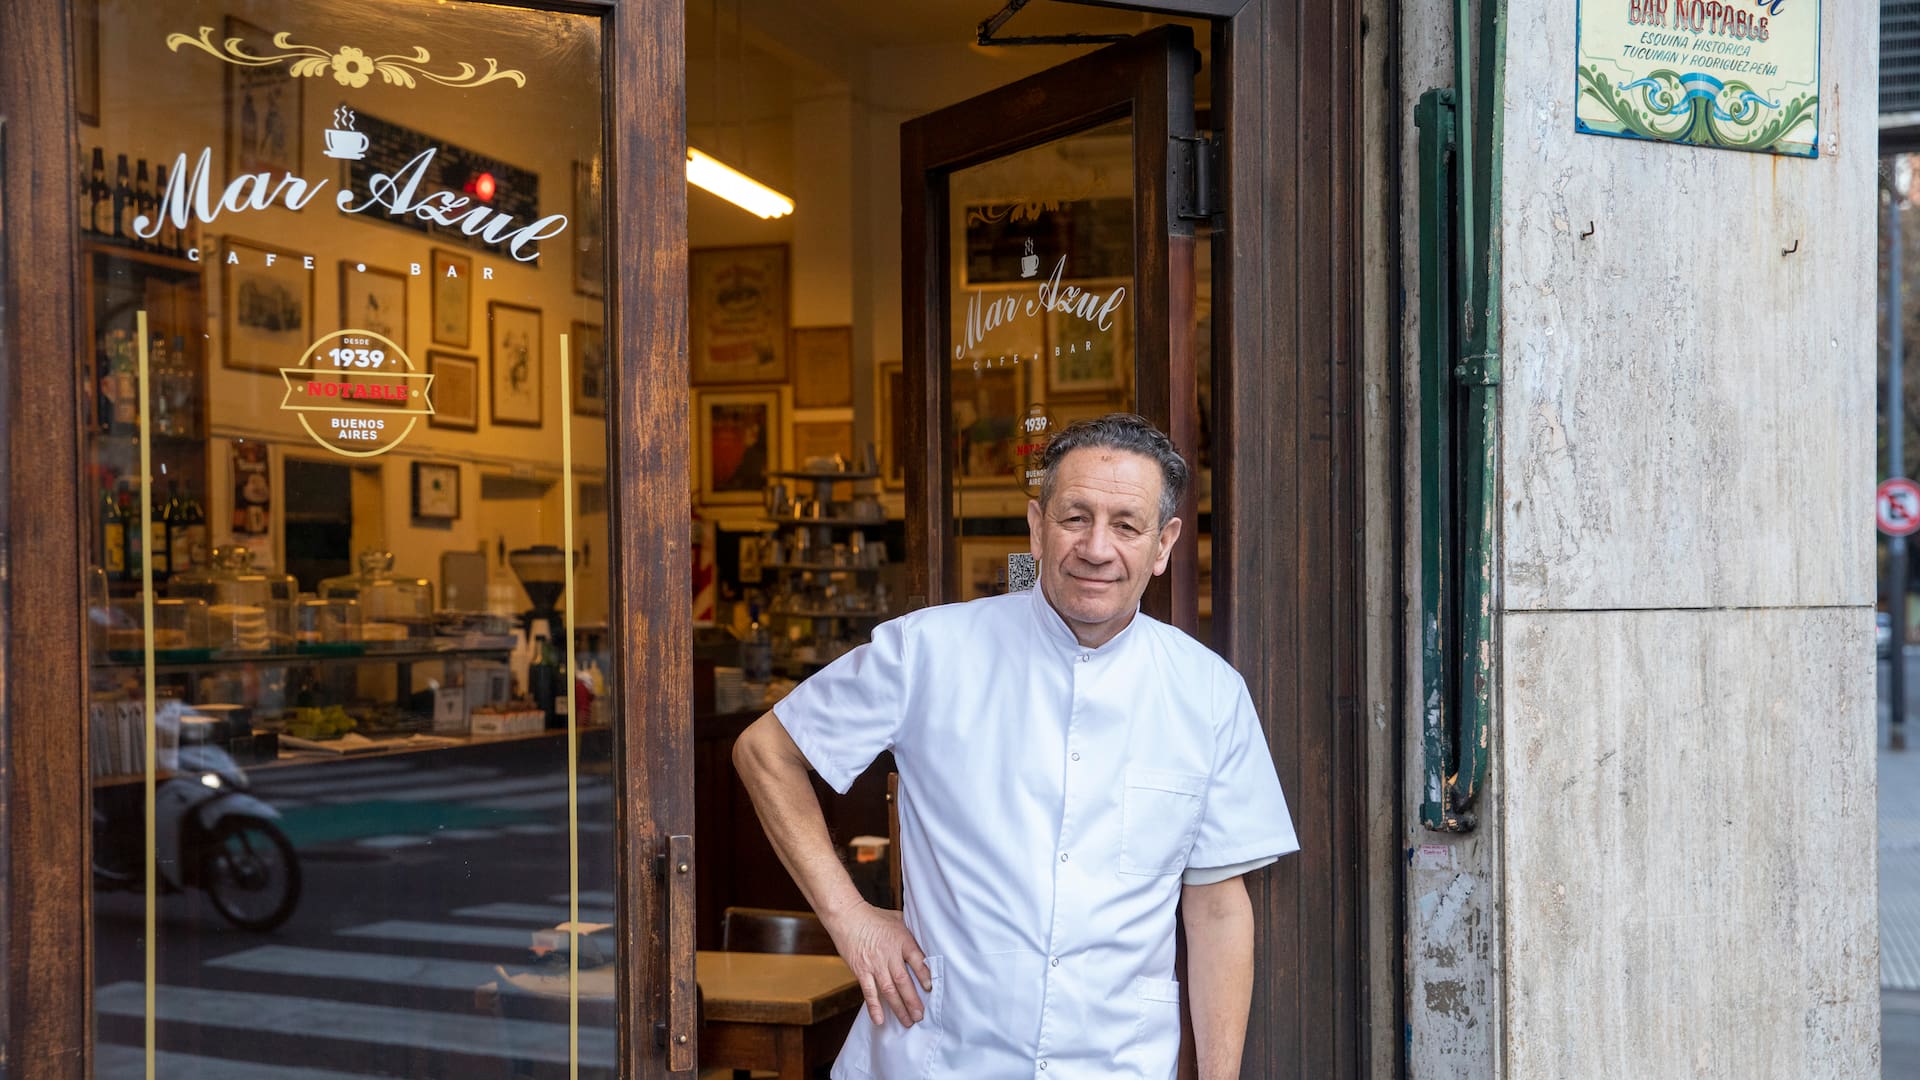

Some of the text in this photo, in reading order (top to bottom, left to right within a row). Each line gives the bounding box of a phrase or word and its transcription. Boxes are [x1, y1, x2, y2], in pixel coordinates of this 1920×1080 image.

[1628, 0, 1667, 29] BAR
[1673, 0, 1769, 41] NOTABLE
[1640, 32, 1751, 57] ESQUINA HISTORICA
[1622, 45, 1679, 63] TUCUMAN
[1680, 55, 1687, 65] Y
[1690, 54, 1750, 72] RODRIGUEZ
[133, 146, 329, 239] Mar
[336, 147, 568, 262] Azul
[187, 248, 494, 280] CAFE BAR
[955, 254, 1126, 360] Mar Azul
[343, 338, 369, 346] DESDE
[328, 348, 385, 368] 1939
[973, 341, 1091, 371] CAFE BAR
[307, 381, 409, 401] NOTABLE
[331, 418, 384, 429] BUENOS
[1025, 416, 1047, 432] 1939
[338, 430, 378, 440] AIRES
[1029, 477, 1041, 486] AIRE
